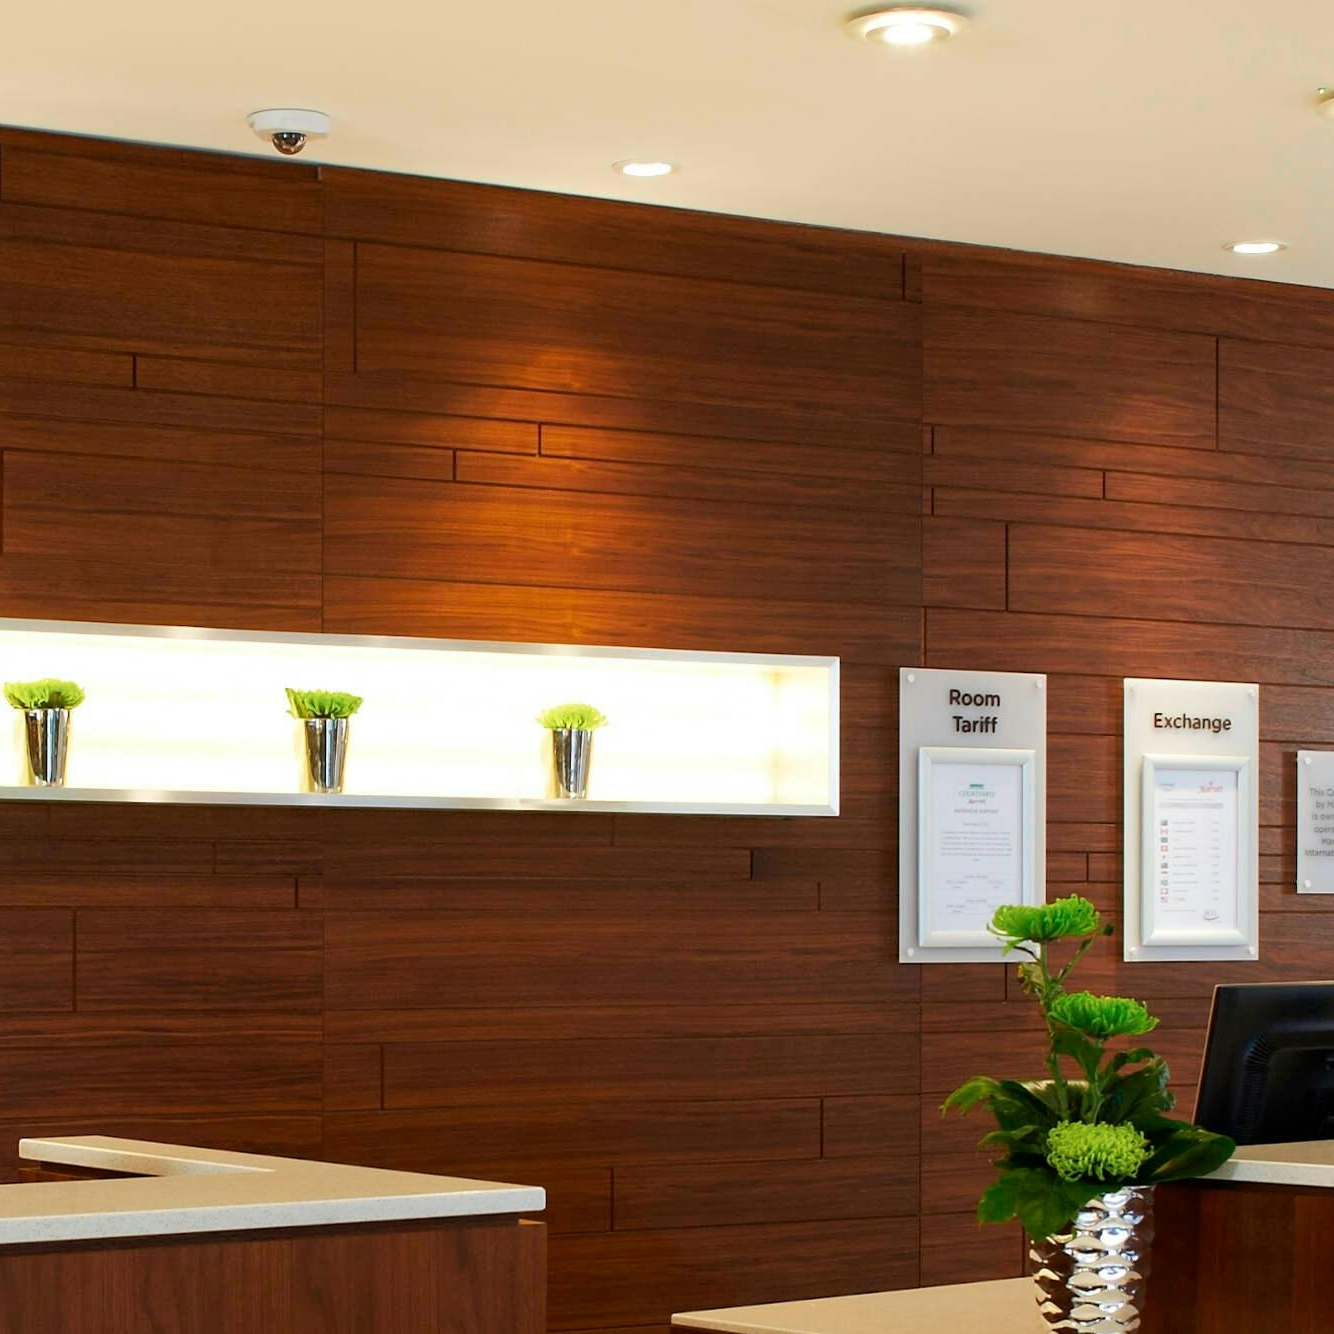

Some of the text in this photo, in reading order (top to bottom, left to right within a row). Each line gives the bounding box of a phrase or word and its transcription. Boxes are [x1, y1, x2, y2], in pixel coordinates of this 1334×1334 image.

[949, 689, 1001, 707] Room
[952, 715, 998, 733] Tariff
[1154, 712, 1232, 733] Exchange
[1309, 788, 1324, 797] This
[1315, 801, 1325, 809] by
